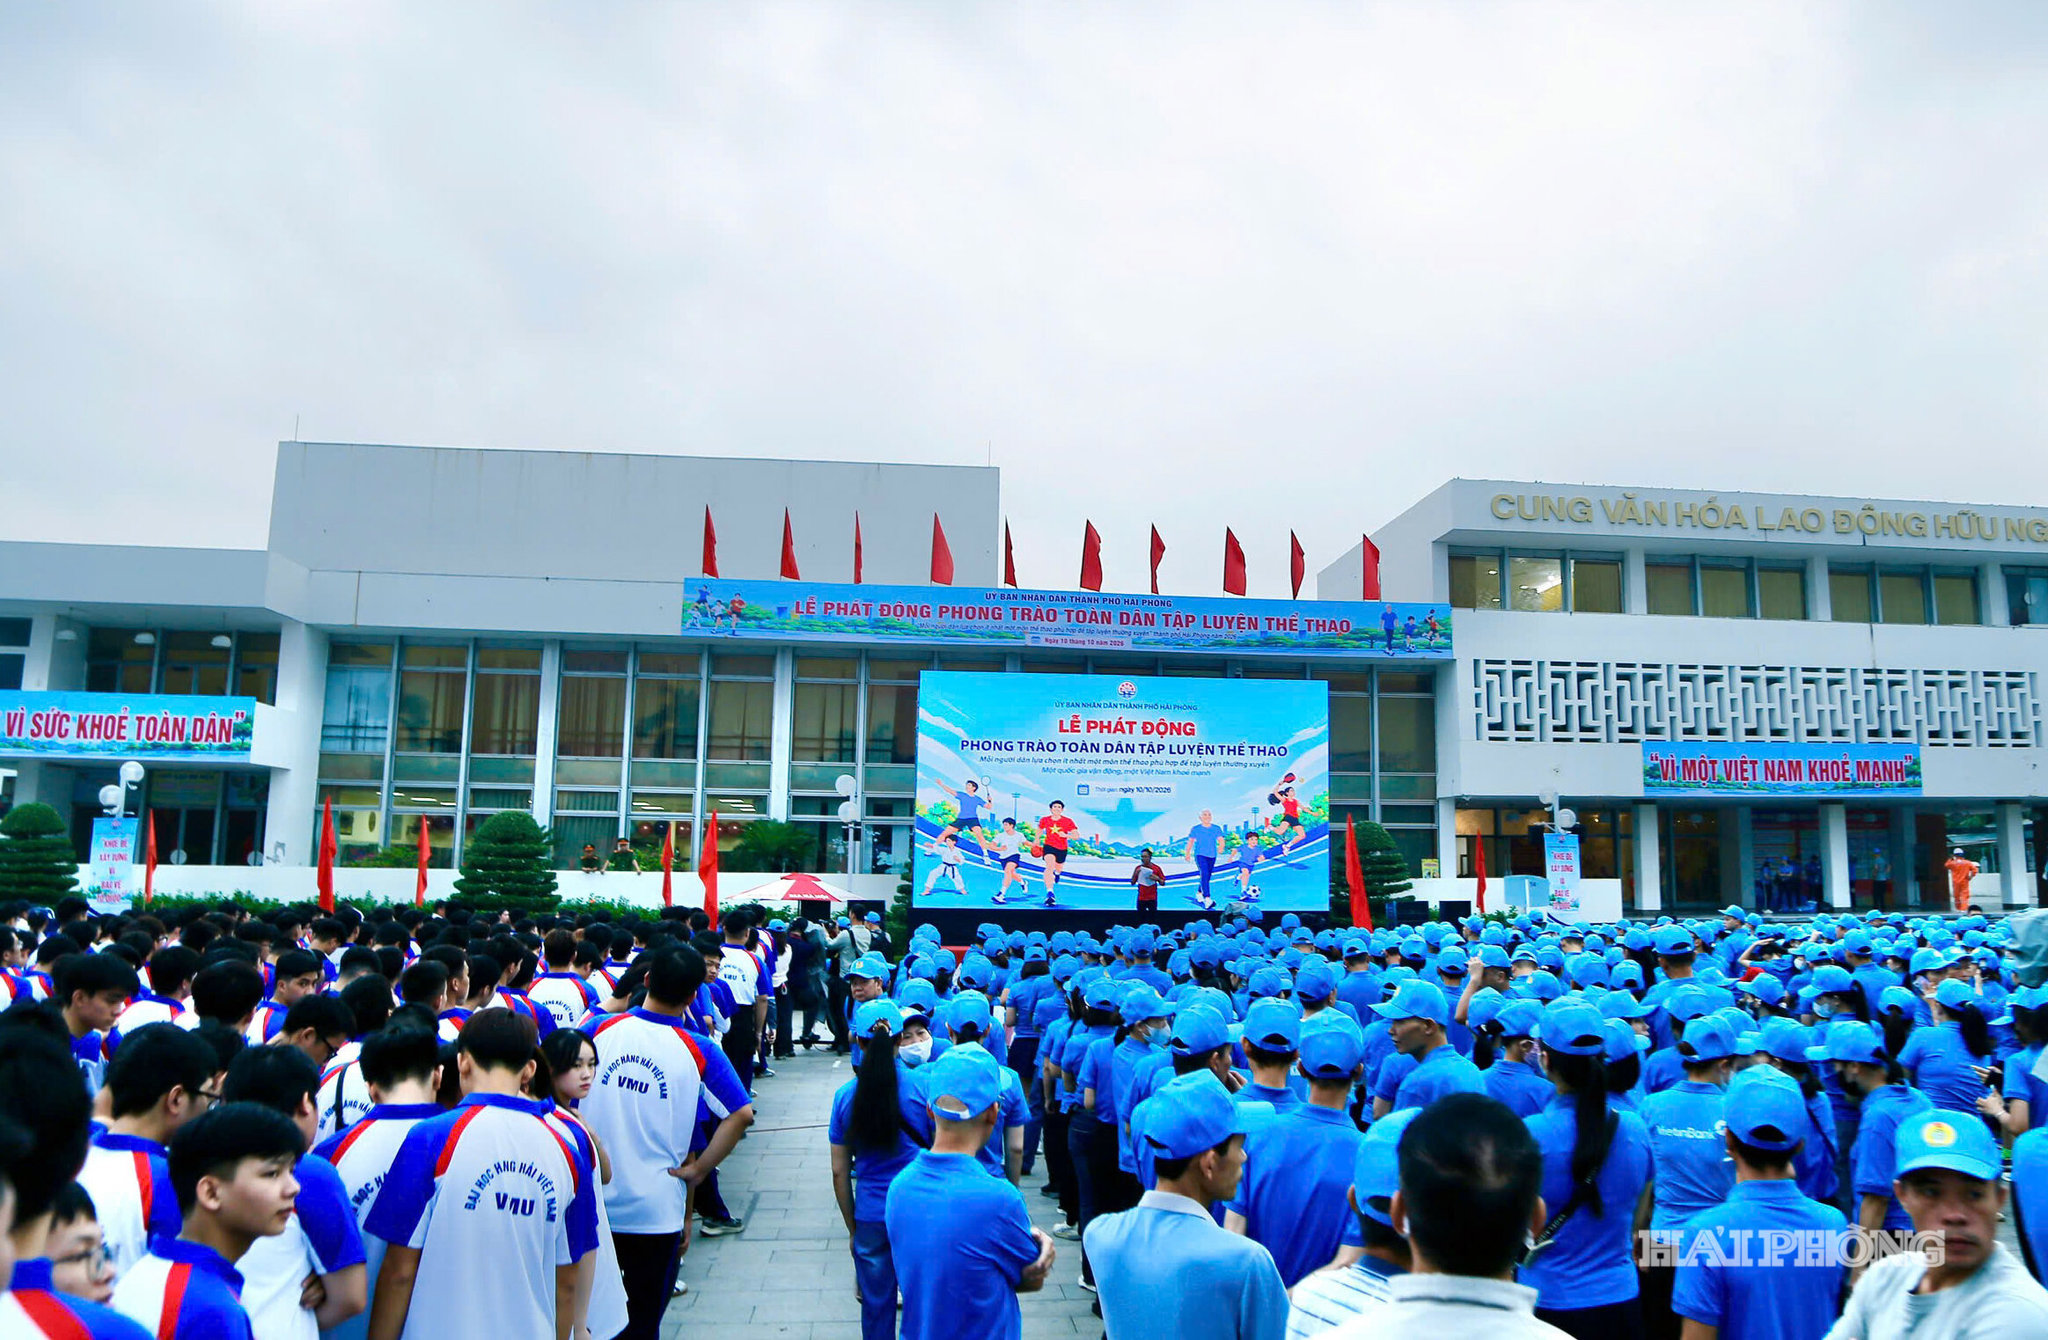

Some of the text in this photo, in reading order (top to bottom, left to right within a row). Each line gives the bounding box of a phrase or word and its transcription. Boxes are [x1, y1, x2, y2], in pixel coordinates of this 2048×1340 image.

[1491, 492, 1593, 522] CUNG
[1600, 492, 1668, 526] VĂN
[1676, 496, 1748, 530] HÓA
[1757, 506, 1825, 533] LAO
[1934, 510, 1999, 540] HỮU
[794, 596, 1351, 633] LỄ PHÁT ĐỘNG PHONG TRÀO TOÀN DÂN TẬP LUYỆN THỂ THAO
[1082, 701, 1102, 709] NHÂN
[1119, 702, 1142, 710] THÀNH
[6, 706, 25, 738] VÌ
[30, 707, 71, 739] SỨC
[76, 706, 129, 740] KHOẺ
[136, 710, 186, 742] TOÀN
[1058, 714, 1196, 738] LỄ PHÁT ĐỘNG
[960, 739, 1288, 758] PHONG TRÀO TOÀN DÂN TẬP LUYỆN THỂ THAO
[1044, 757, 1062, 765] chọn
[1150, 759, 1164, 768] phù
[1165, 759, 1179, 768] hợp
[1202, 760, 1222, 768] luyện
[1076, 768, 1088, 776] gia
[1140, 768, 1156, 776] Việt
[1682, 754, 1718, 787] MỘT
[1723, 754, 1758, 787] VIỆT
[1764, 760, 1804, 782] NAM
[1808, 753, 1851, 782] KHOẺ
[1119, 786, 1134, 794] ngày
[608, 1059, 621, 1074] HỌC
[651, 1066, 665, 1082] VIỆT
[658, 1082, 668, 1100] NAM
[618, 1075, 650, 1094] VMU
[464, 1189, 481, 1211] ĐẠI
[474, 1168, 494, 1190] HỌC
[519, 1162, 538, 1178] HẢI
[536, 1172, 555, 1196] VIỆT
